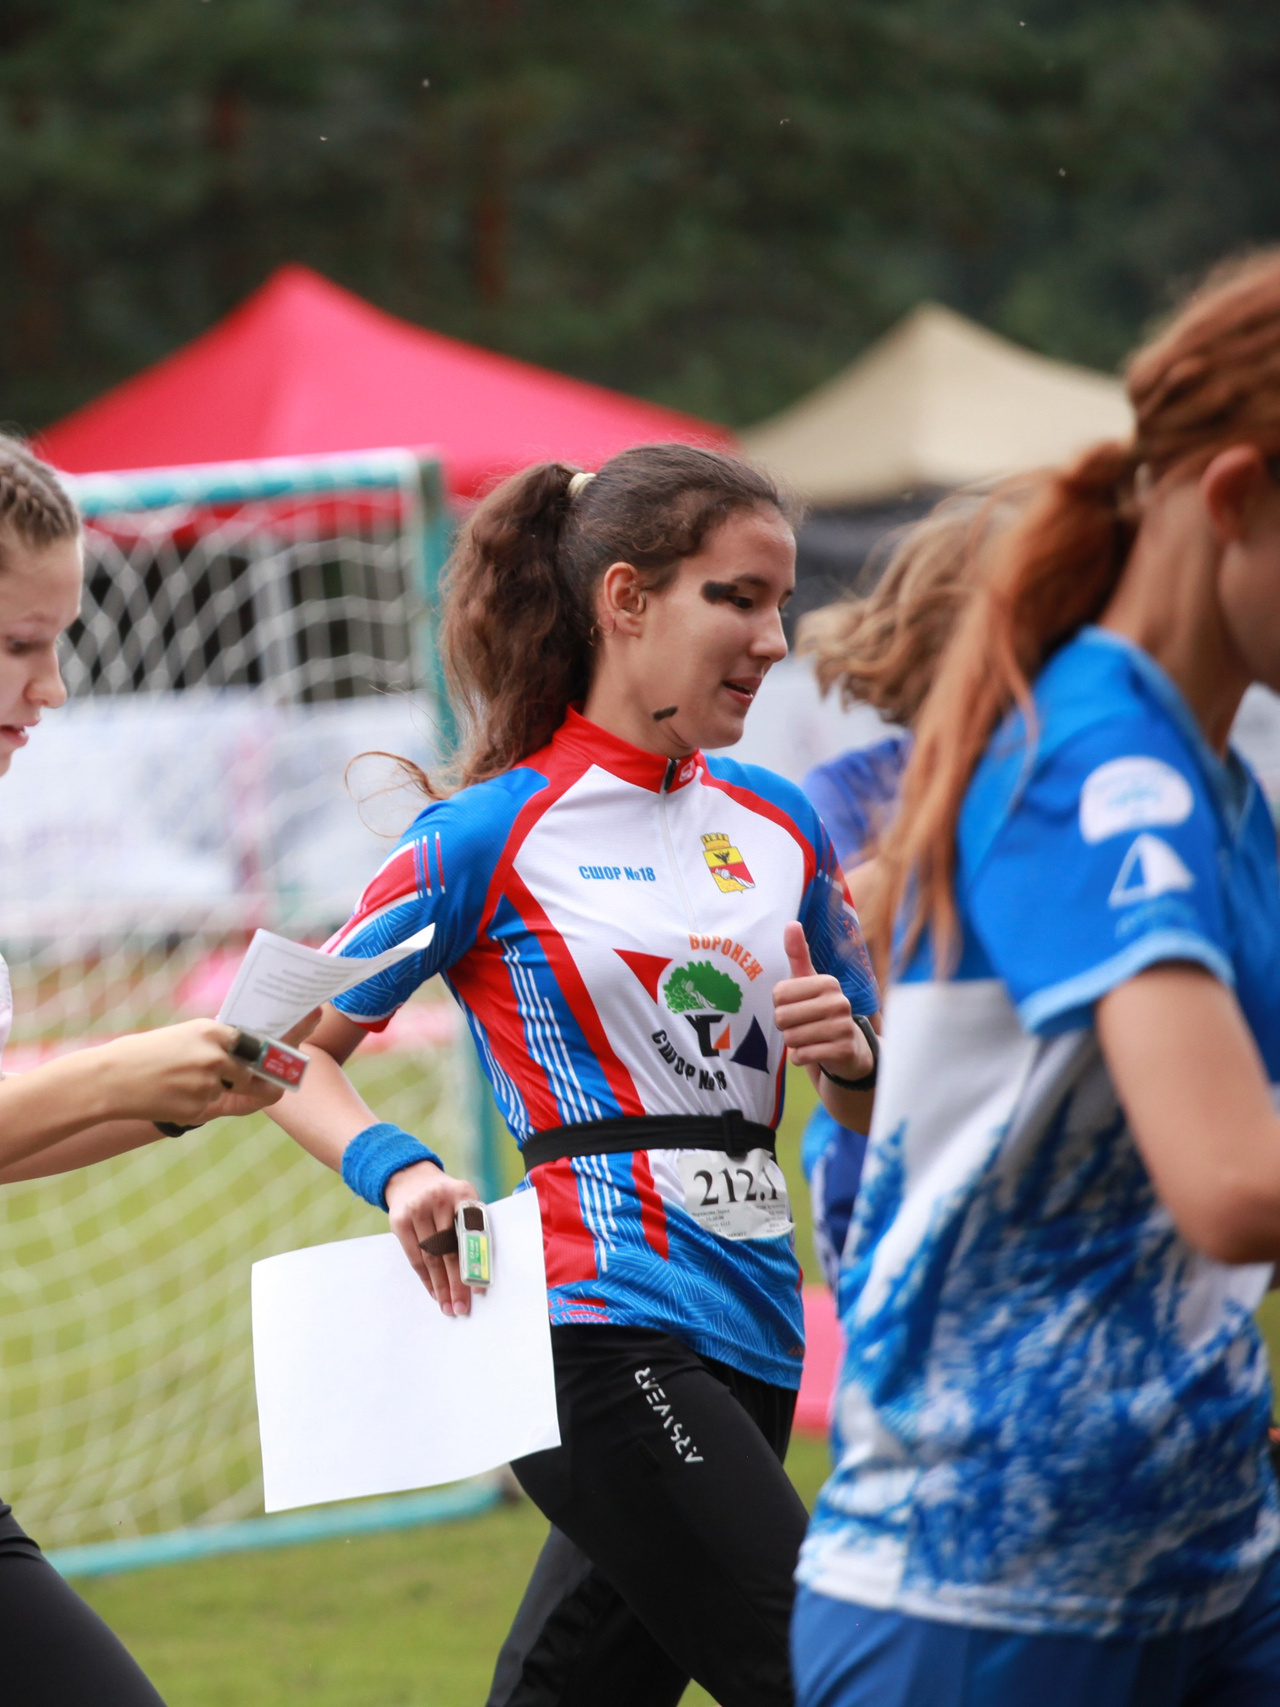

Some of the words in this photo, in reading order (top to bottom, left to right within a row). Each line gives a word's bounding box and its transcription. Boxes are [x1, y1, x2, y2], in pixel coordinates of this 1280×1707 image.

[578, 866, 621, 880] СШОР
[688, 933, 764, 981] ВОРОНЕЖ
[651, 1029, 696, 1081] СШОР
[693, 1166, 779, 1206] 212.1
